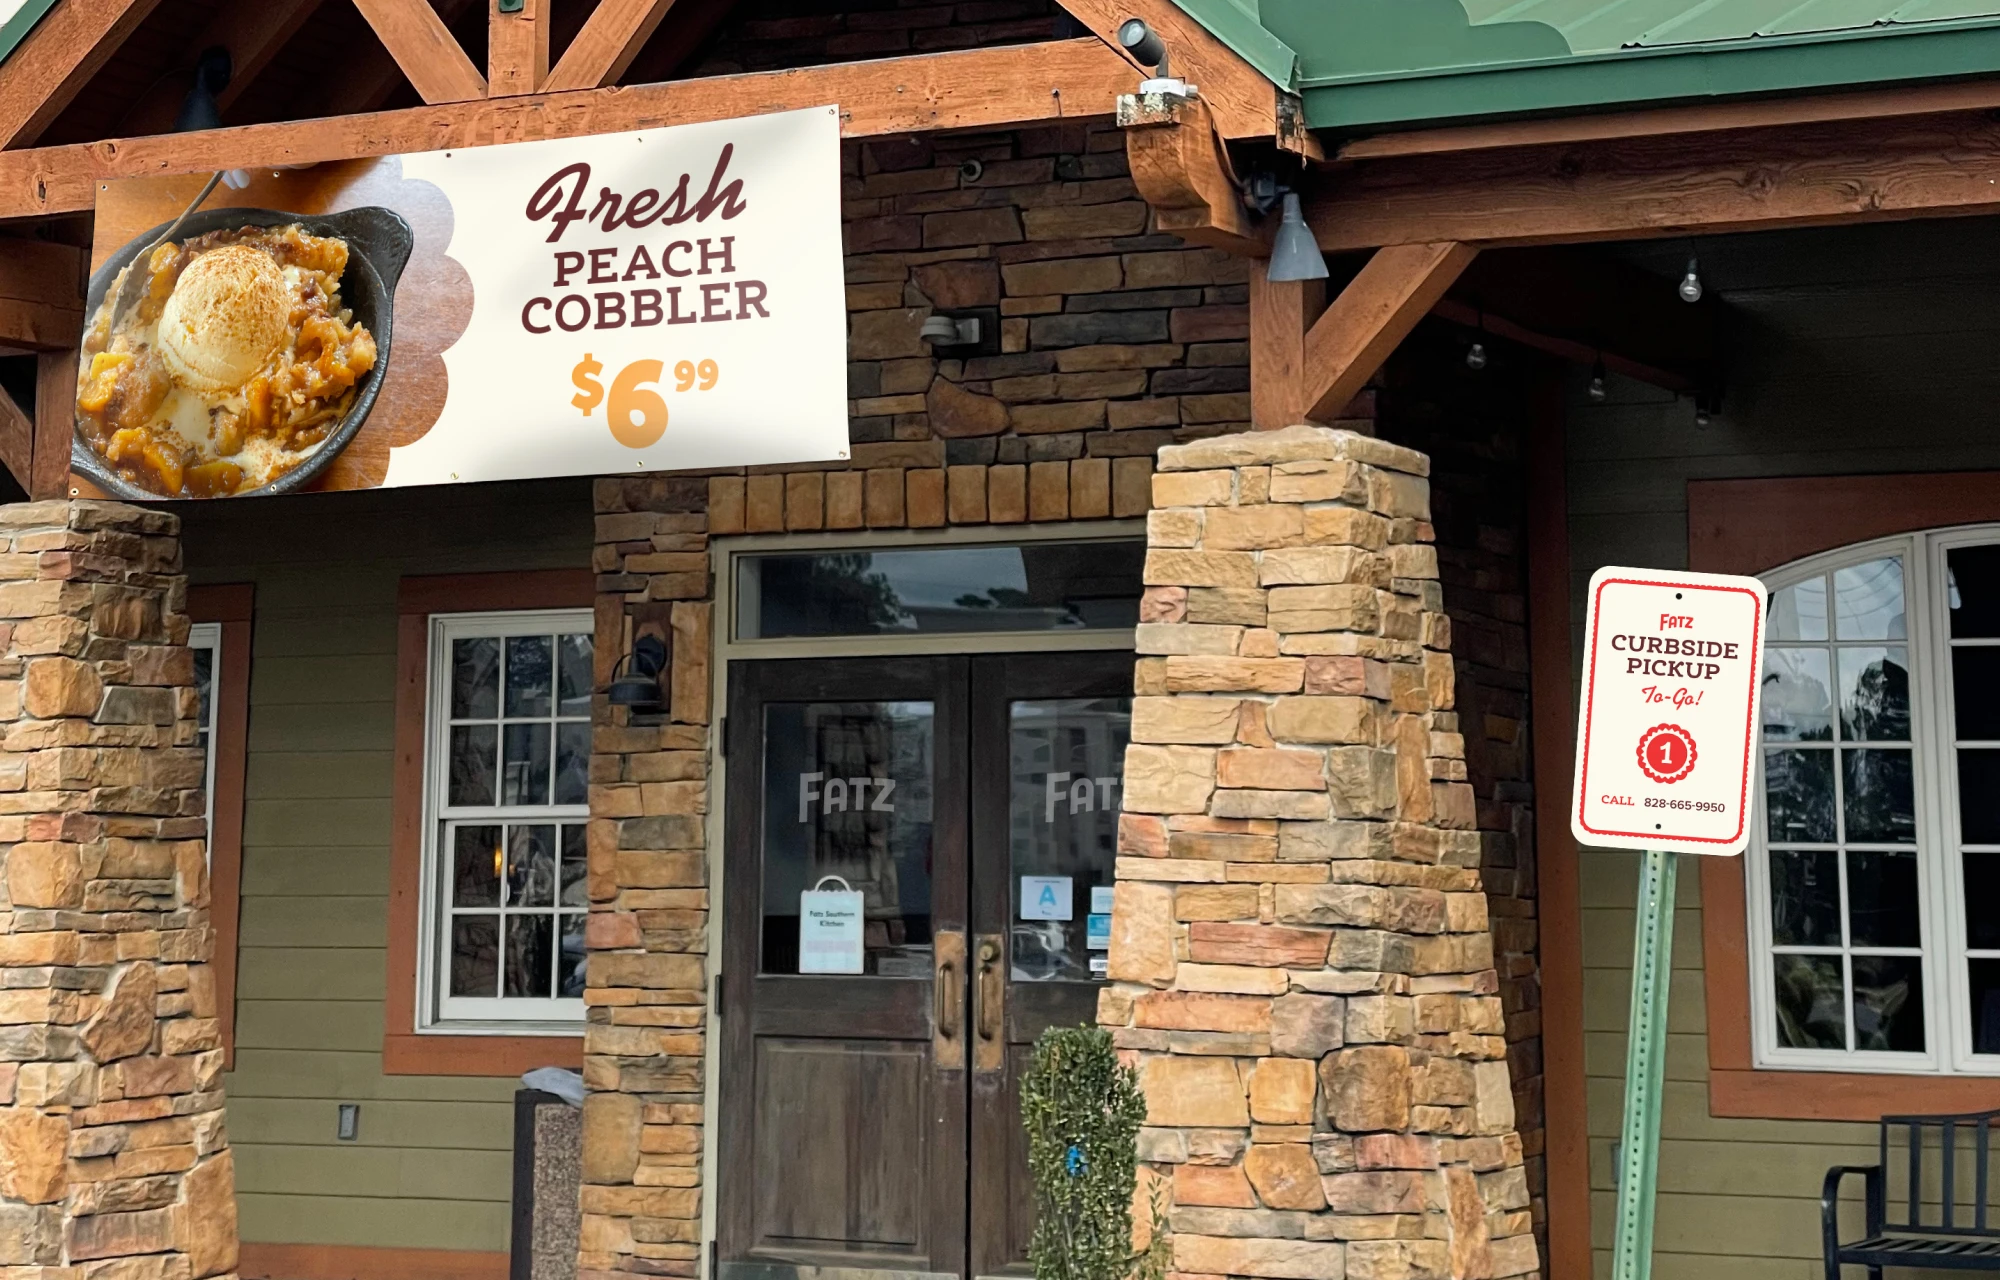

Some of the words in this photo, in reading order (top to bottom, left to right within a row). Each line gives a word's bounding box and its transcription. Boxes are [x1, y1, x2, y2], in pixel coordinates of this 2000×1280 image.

[525, 142, 747, 244] Fresh
[553, 236, 736, 288] PEACH
[521, 279, 770, 335] COBBLER
[1611, 634, 1739, 660] CURBSIDE
[1626, 657, 1721, 680] PICKUP
[1641, 685, 1704, 710] To-Go!
[1659, 741, 1673, 765] 1
[1045, 771, 1125, 823] FAT
[1601, 795, 1635, 807] CALL
[1644, 797, 1726, 814] 828-665-9950
[1038, 883, 1057, 906] A
